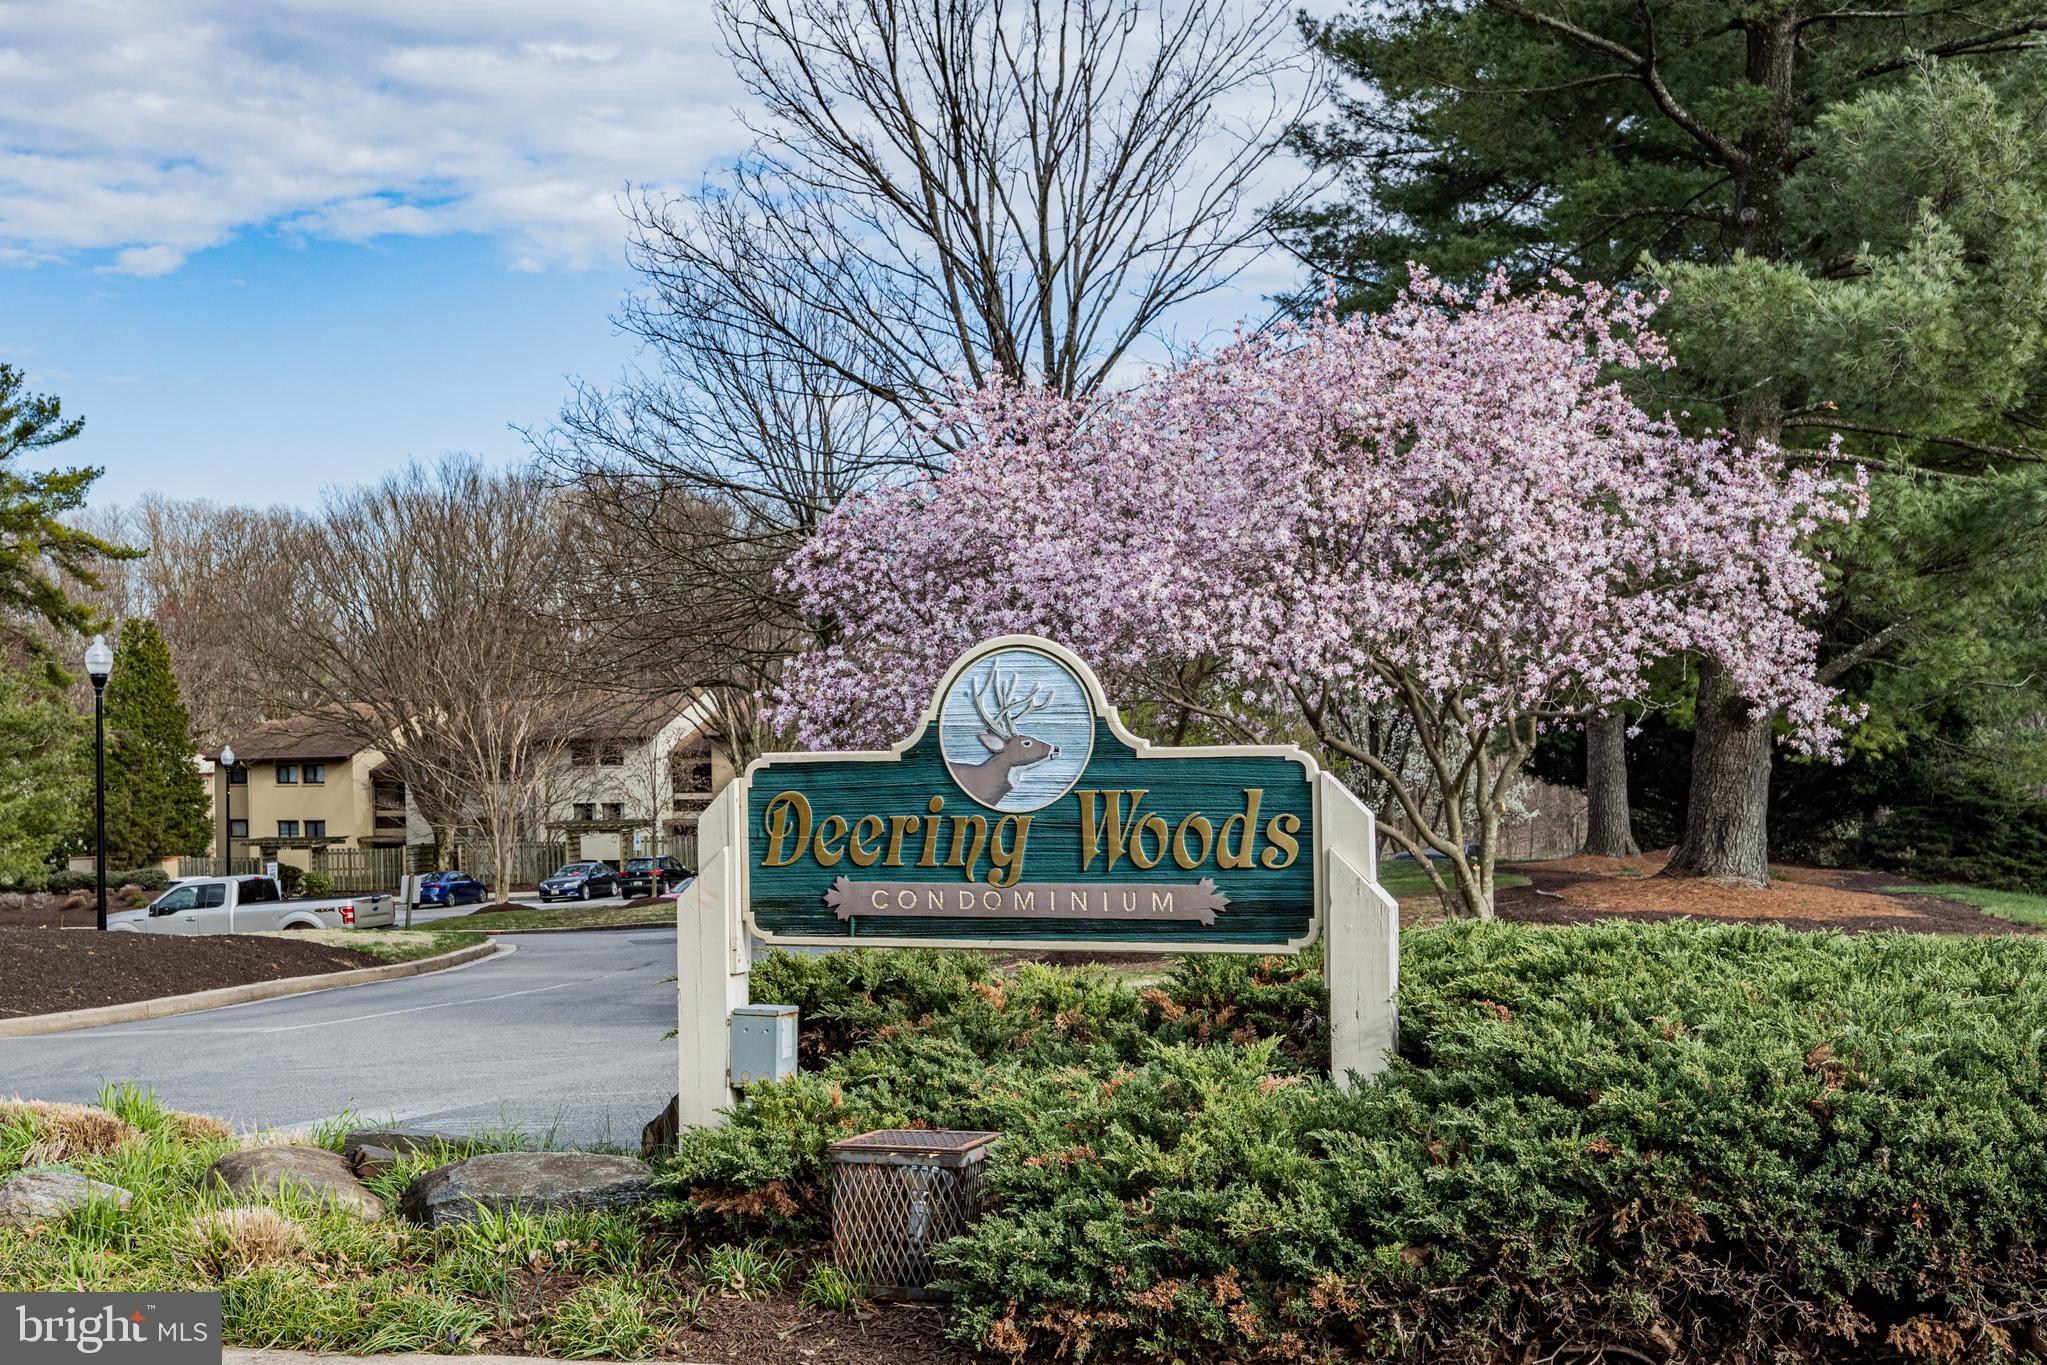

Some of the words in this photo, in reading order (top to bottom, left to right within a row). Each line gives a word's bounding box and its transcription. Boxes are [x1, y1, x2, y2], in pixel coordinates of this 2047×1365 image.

[761, 790, 1035, 887] Deering
[1074, 788, 1301, 872] Woods
[871, 890, 1174, 912] CONDOMINIUM
